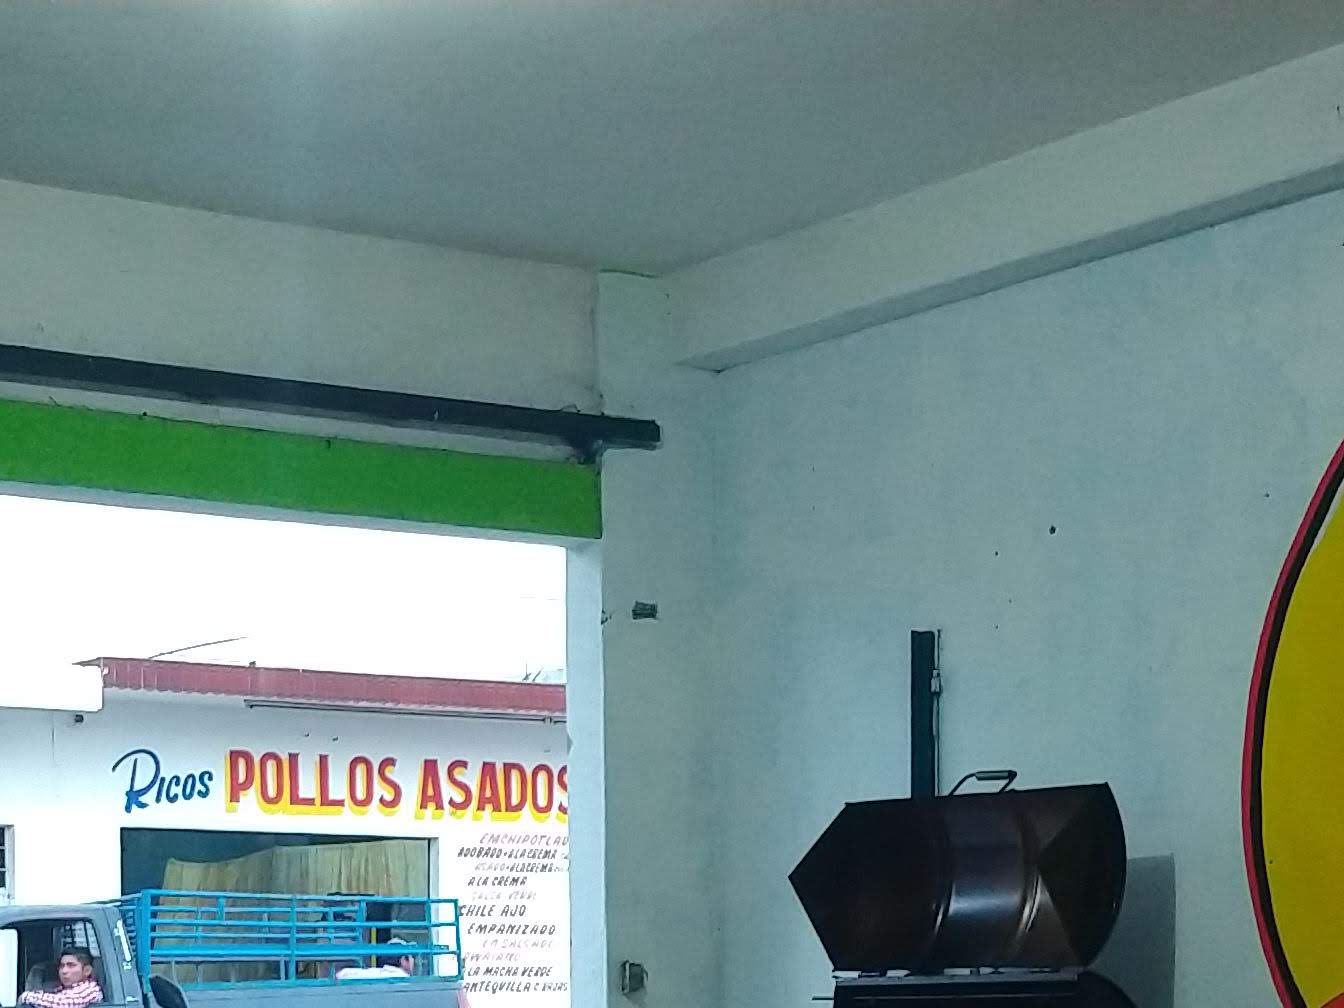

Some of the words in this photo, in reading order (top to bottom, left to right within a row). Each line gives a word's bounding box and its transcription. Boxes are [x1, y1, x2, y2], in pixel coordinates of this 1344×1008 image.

[226, 749, 403, 814] POLLOS
[491, 875, 528, 887] CREMA
[459, 904, 496, 917] CHILE
[500, 904, 527, 917] AJO
[467, 922, 556, 936] EMPANIZADO
[463, 981, 532, 995] ANTEQUILLA
